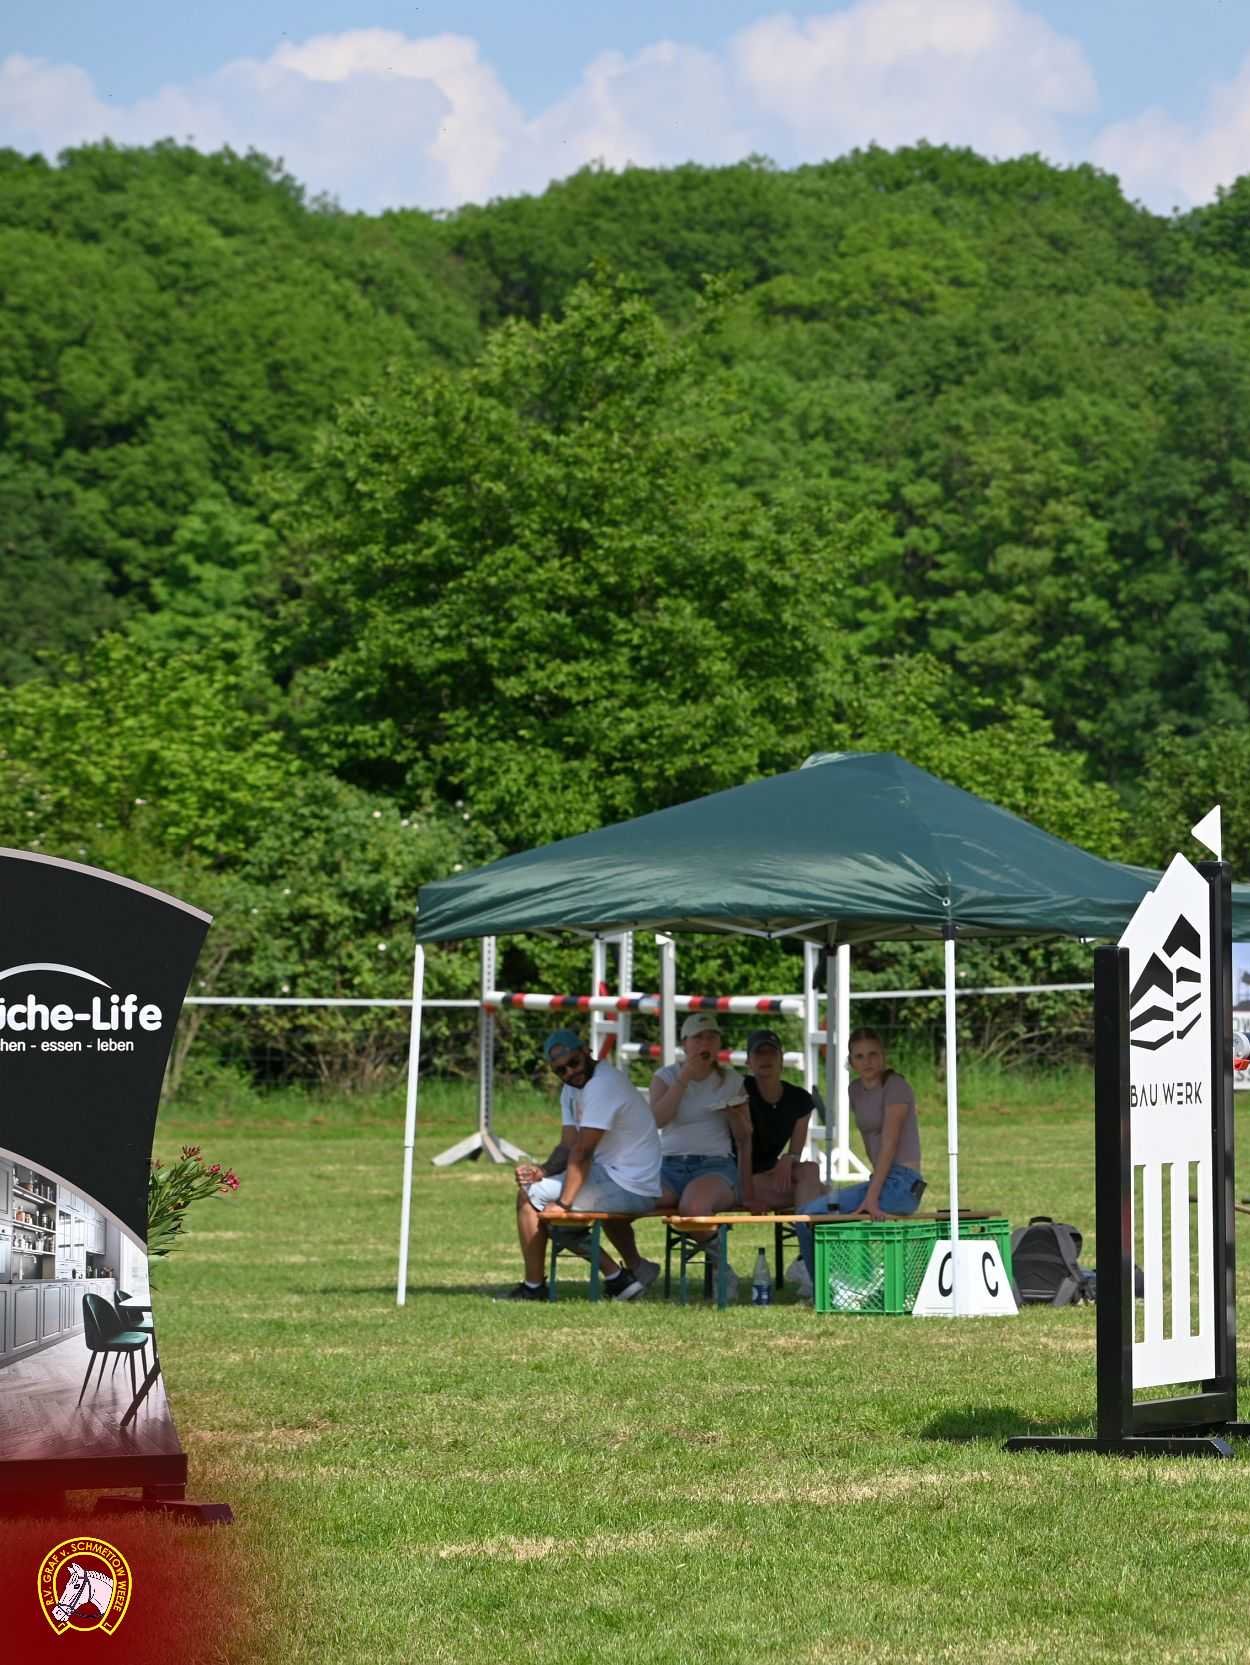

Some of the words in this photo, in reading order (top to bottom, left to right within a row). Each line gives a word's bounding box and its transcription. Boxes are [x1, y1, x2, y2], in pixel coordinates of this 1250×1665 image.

[40, 1040, 82, 1052] essen
[97, 1038, 134, 1052] leben
[1130, 1083, 1158, 1108] BAU
[1162, 1081, 1202, 1106] WERK
[982, 1251, 999, 1298] C
